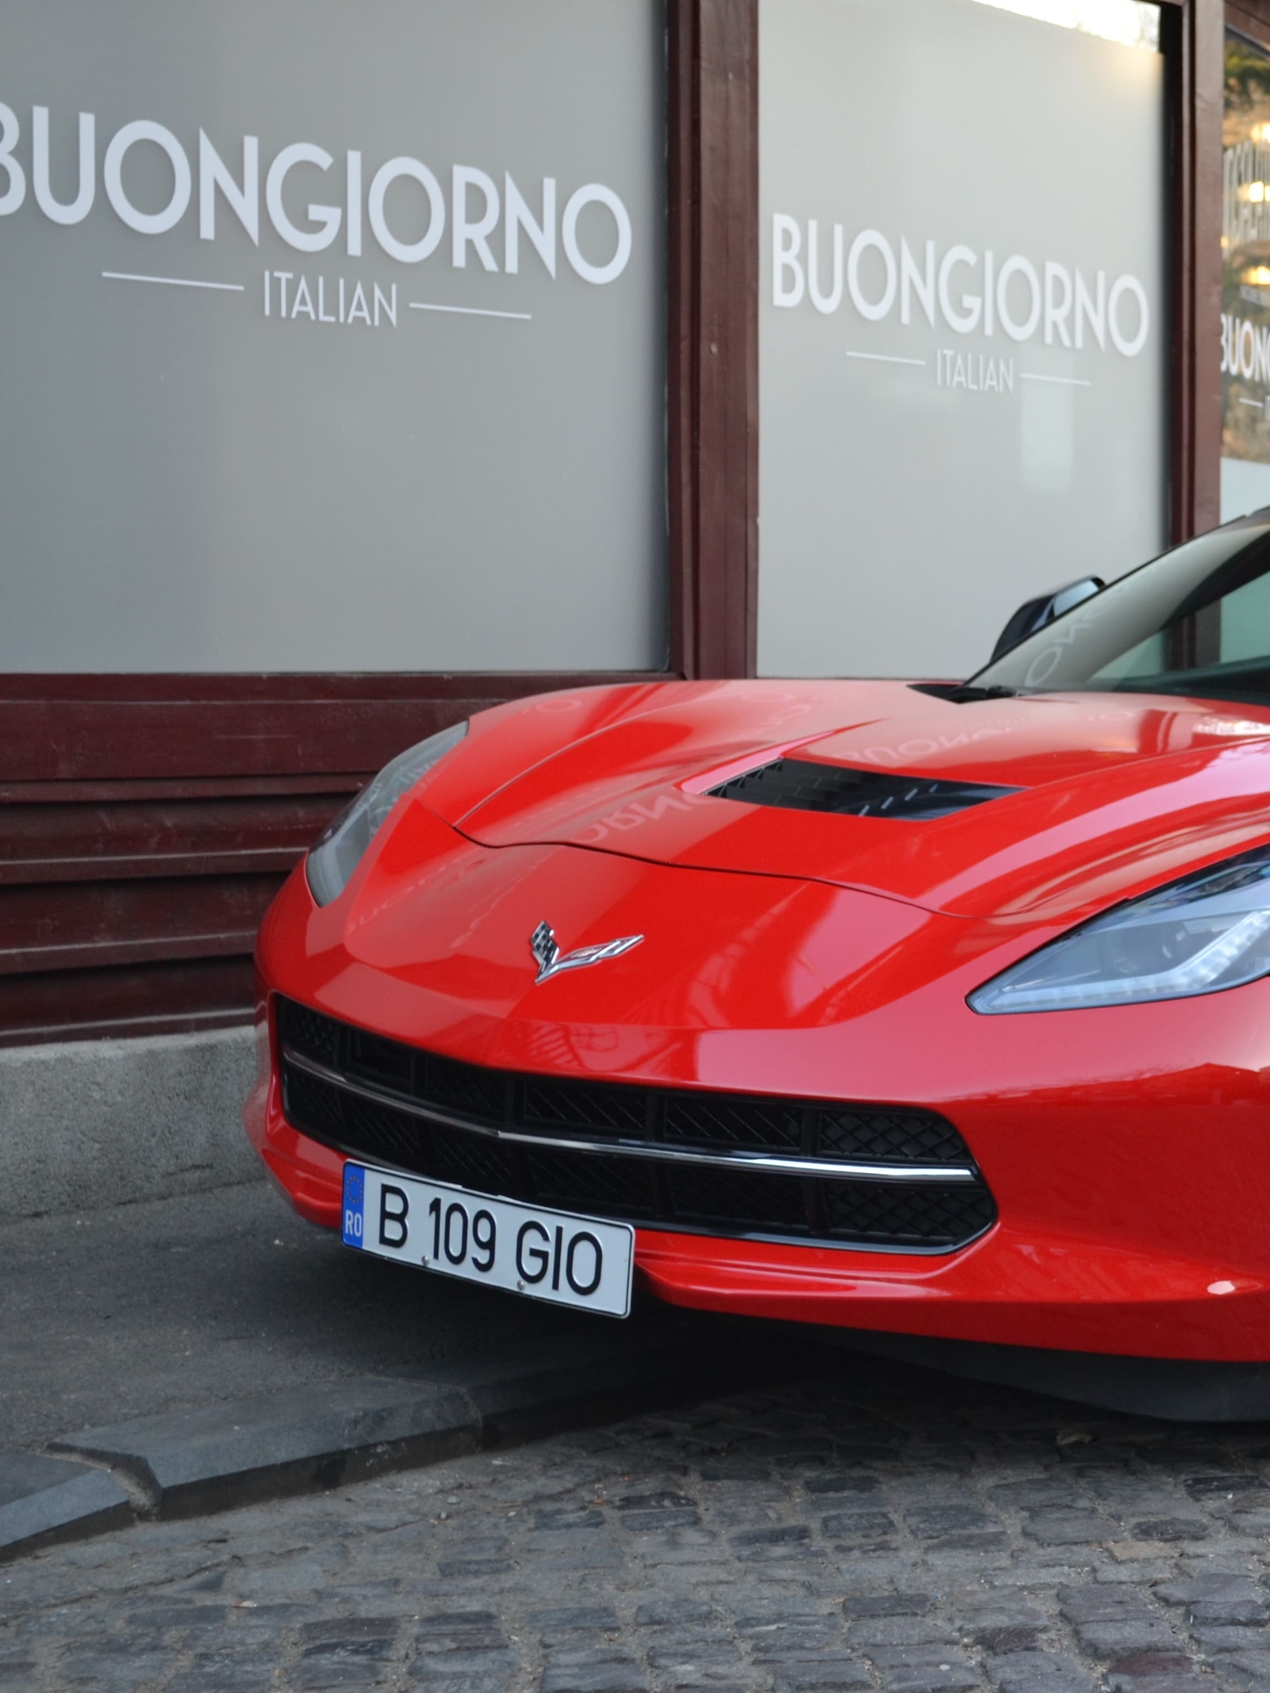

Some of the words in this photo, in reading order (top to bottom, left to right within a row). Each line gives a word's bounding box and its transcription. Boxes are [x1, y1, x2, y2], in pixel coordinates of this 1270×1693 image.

[264, 270, 397, 328] ITALIAN
[773, 213, 1149, 356] BUONGIORNO
[936, 349, 1014, 393] ITALIAN
[345, 1210, 362, 1237] RO
[379, 1184, 408, 1248] B
[430, 1198, 495, 1272] 109
[516, 1221, 602, 1295] GIO
